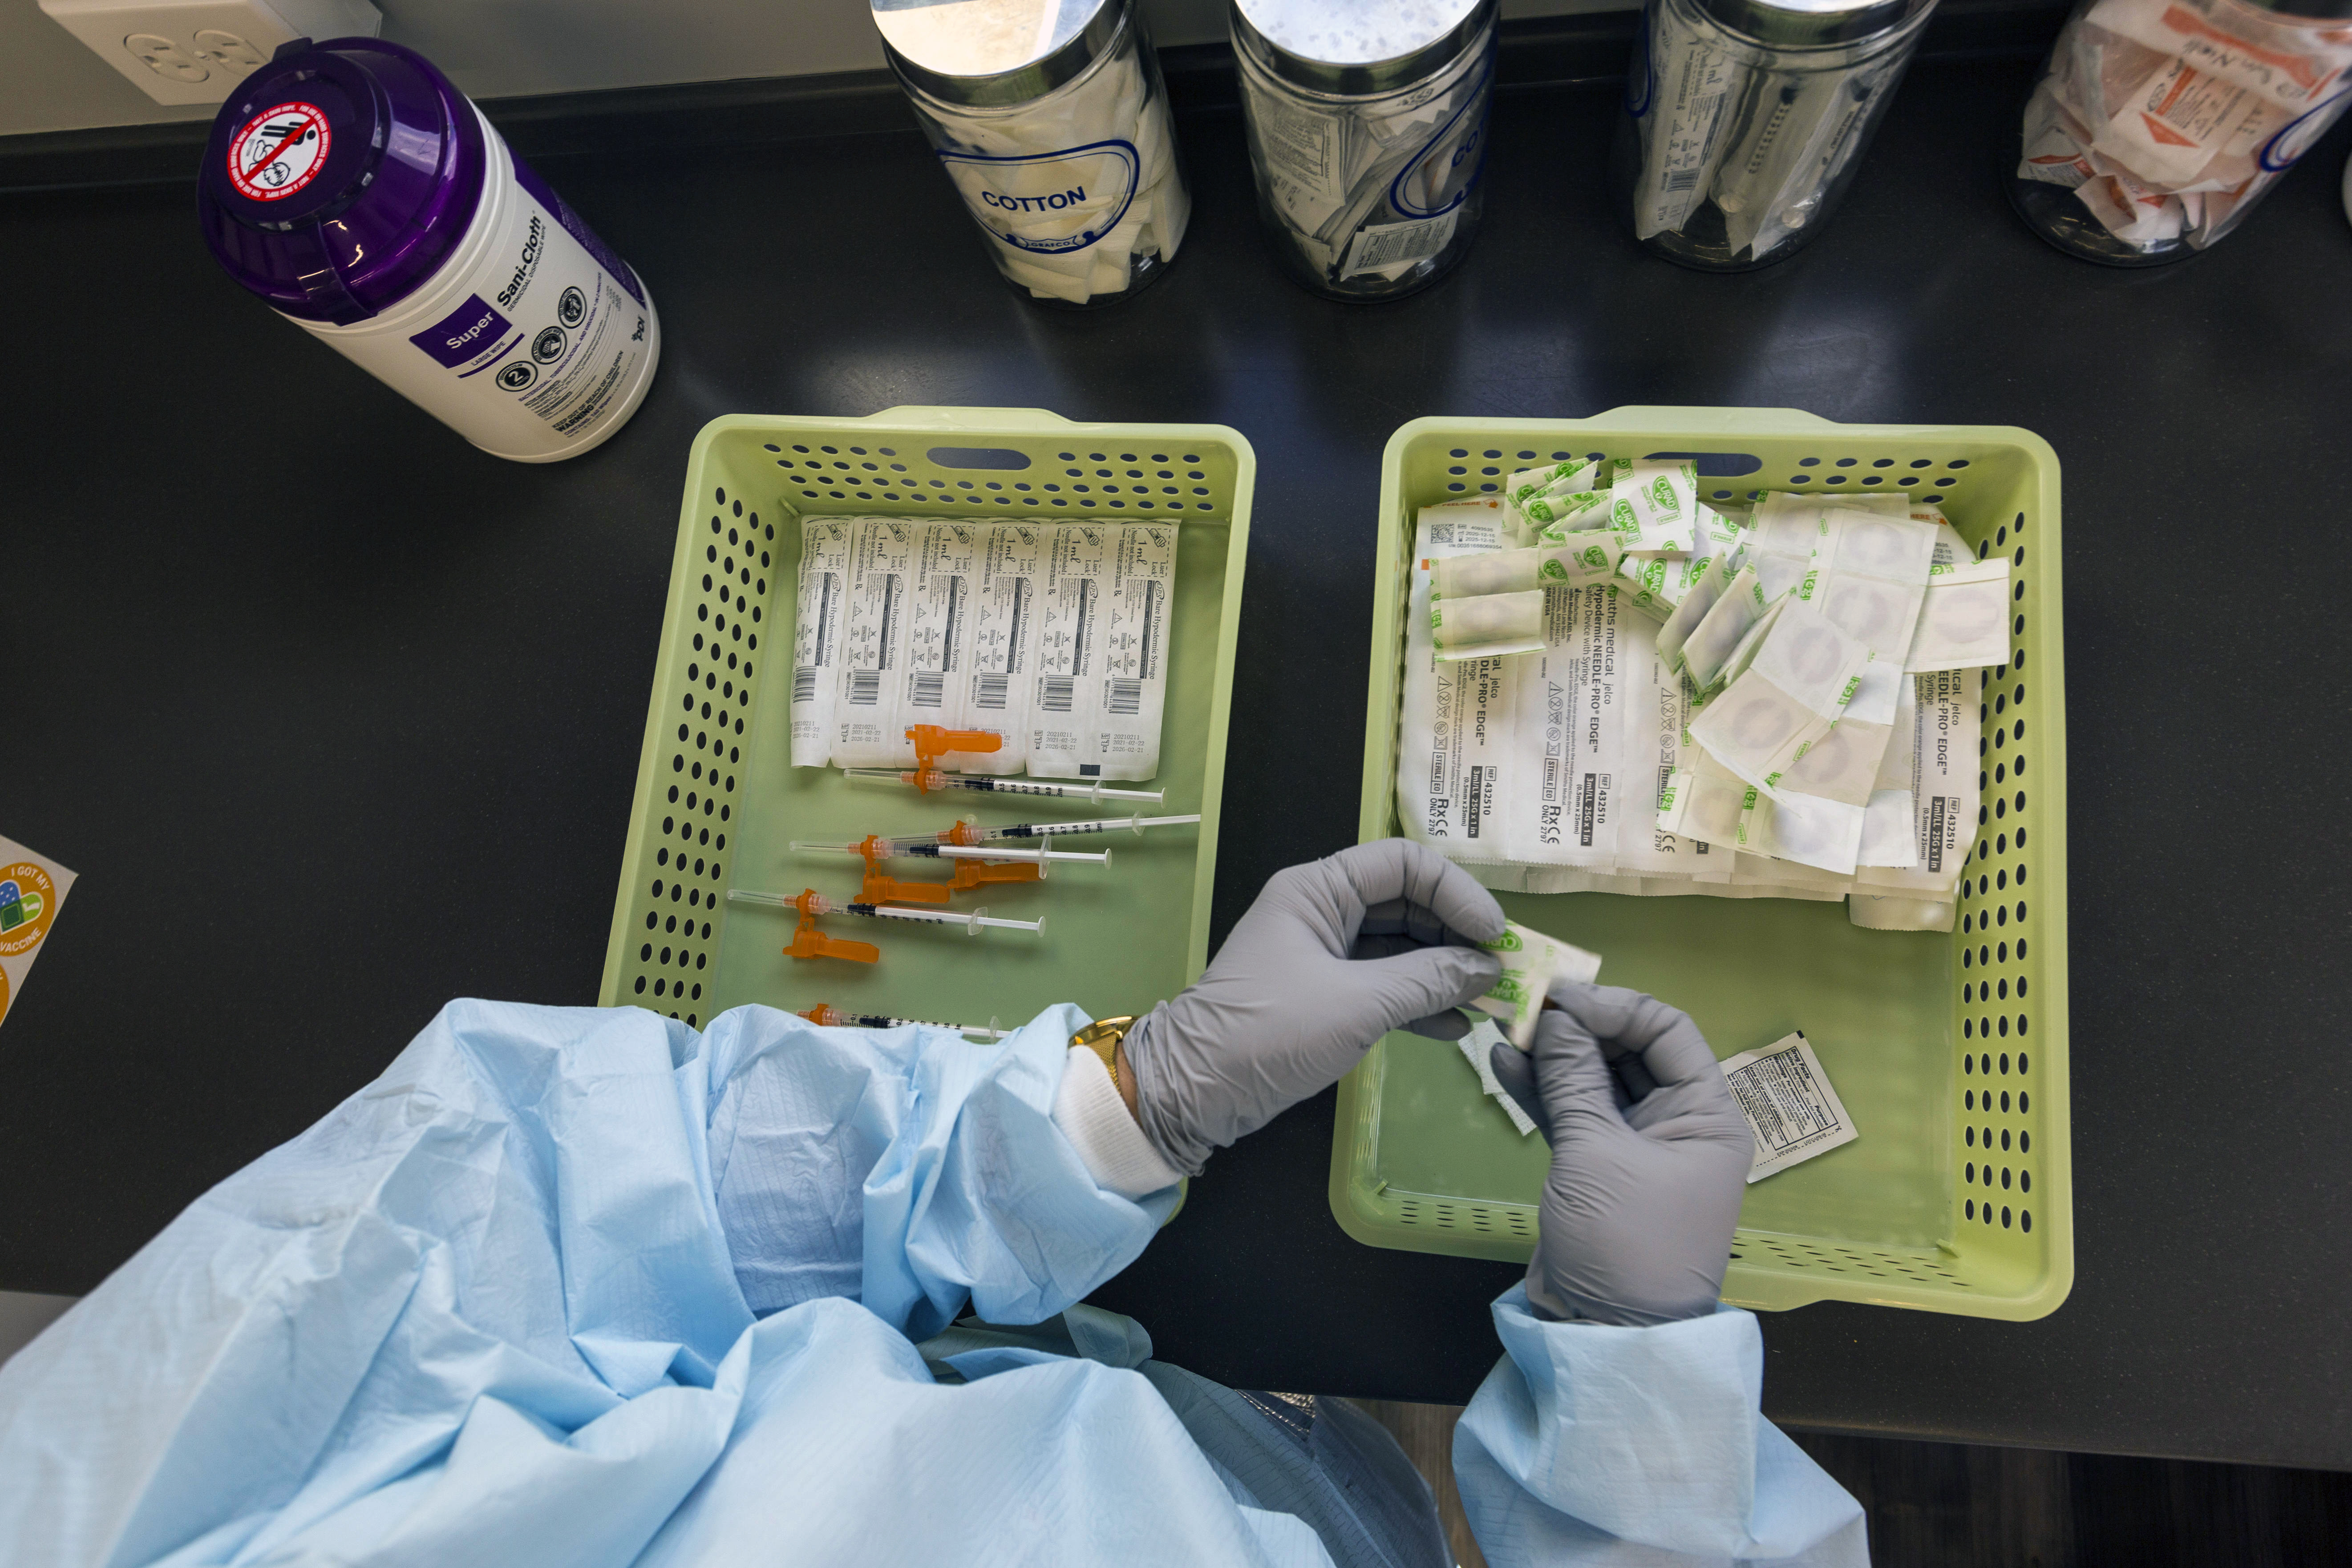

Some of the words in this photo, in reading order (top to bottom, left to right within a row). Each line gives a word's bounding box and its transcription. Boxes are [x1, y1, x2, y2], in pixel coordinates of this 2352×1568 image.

[981, 186, 1086, 213] COTTON
[1031, 239, 1071, 249] GRAFCO
[497, 216, 541, 307] Sani-Cloth
[446, 312, 494, 349] Super
[471, 351, 490, 366] LARGE
[488, 341, 506, 356] WIPE
[508, 371, 523, 385] 2
[552, 418, 567, 428] KEEP
[567, 409, 579, 420] OUT
[585, 387, 602, 404] REACH
[600, 379, 607, 387] OF
[606, 350, 624, 379] CHILDREN
[555, 404, 594, 432] WARNING
[1656, 480, 1676, 507] CURAD
[1618, 503, 1636, 531] CURAD
[816, 543, 825, 558] ml
[877, 542, 888, 559] ml
[941, 543, 951, 561] ml
[1005, 545, 1016, 562] ml
[1070, 546, 1081, 563] ml
[1137, 547, 1147, 565] ml
[1589, 547, 1606, 567] CURAD
[1651, 562, 1664, 592] CURAD
[828, 606, 837, 644] Hypodermic
[890, 608, 899, 646] Hypodermic
[1583, 610, 1593, 636] Device
[1593, 586, 1605, 643] Hypodermic
[955, 611, 964, 648] Hypodermic
[1020, 613, 1029, 651] Hypodermic
[1085, 614, 1095, 652] Hypodermic
[1152, 616, 1161, 654] Hypodermic
[824, 644, 833, 668] Syringe
[1583, 637, 1591, 655] with
[1605, 628, 1615, 676] medical
[887, 647, 895, 671] Syringe
[951, 649, 959, 673] Syringe
[1016, 651, 1024, 675] Syringe
[1082, 653, 1090, 677] Syringe
[1149, 656, 1157, 680] Syringe
[1580, 656, 1591, 686] Syringe
[1490, 678, 1501, 698] jelco
[1603, 683, 1614, 705] jelco
[1925, 674, 1936, 705] Syringe
[1938, 671, 1949, 736] EEDLE-PRO®
[1951, 702, 1961, 725] jelco
[1434, 754, 1442, 780] STERILE
[1546, 761, 1555, 787] STERILE
[1437, 798, 1449, 818] Rx
[1483, 782, 1492, 815] 432510
[1597, 790, 1607, 824] 432510
[1541, 805, 1549, 824] ONLY
[1549, 806, 1561, 825] Rx
[1470, 826, 1477, 834] in
[1932, 831, 1940, 846] 25G
[1947, 814, 1956, 849] 432510
[11, 867, 15, 877] I
[16, 865, 37, 878] GOT
[35, 873, 50, 890] MY
[0, 927, 42, 952] VACCINE
[1773, 1056, 1787, 1078] Warnings
[1791, 1049, 1801, 1062] Drug
[1798, 1063, 1810, 1079] Facts
[1814, 1105, 1828, 1126] Purpose
